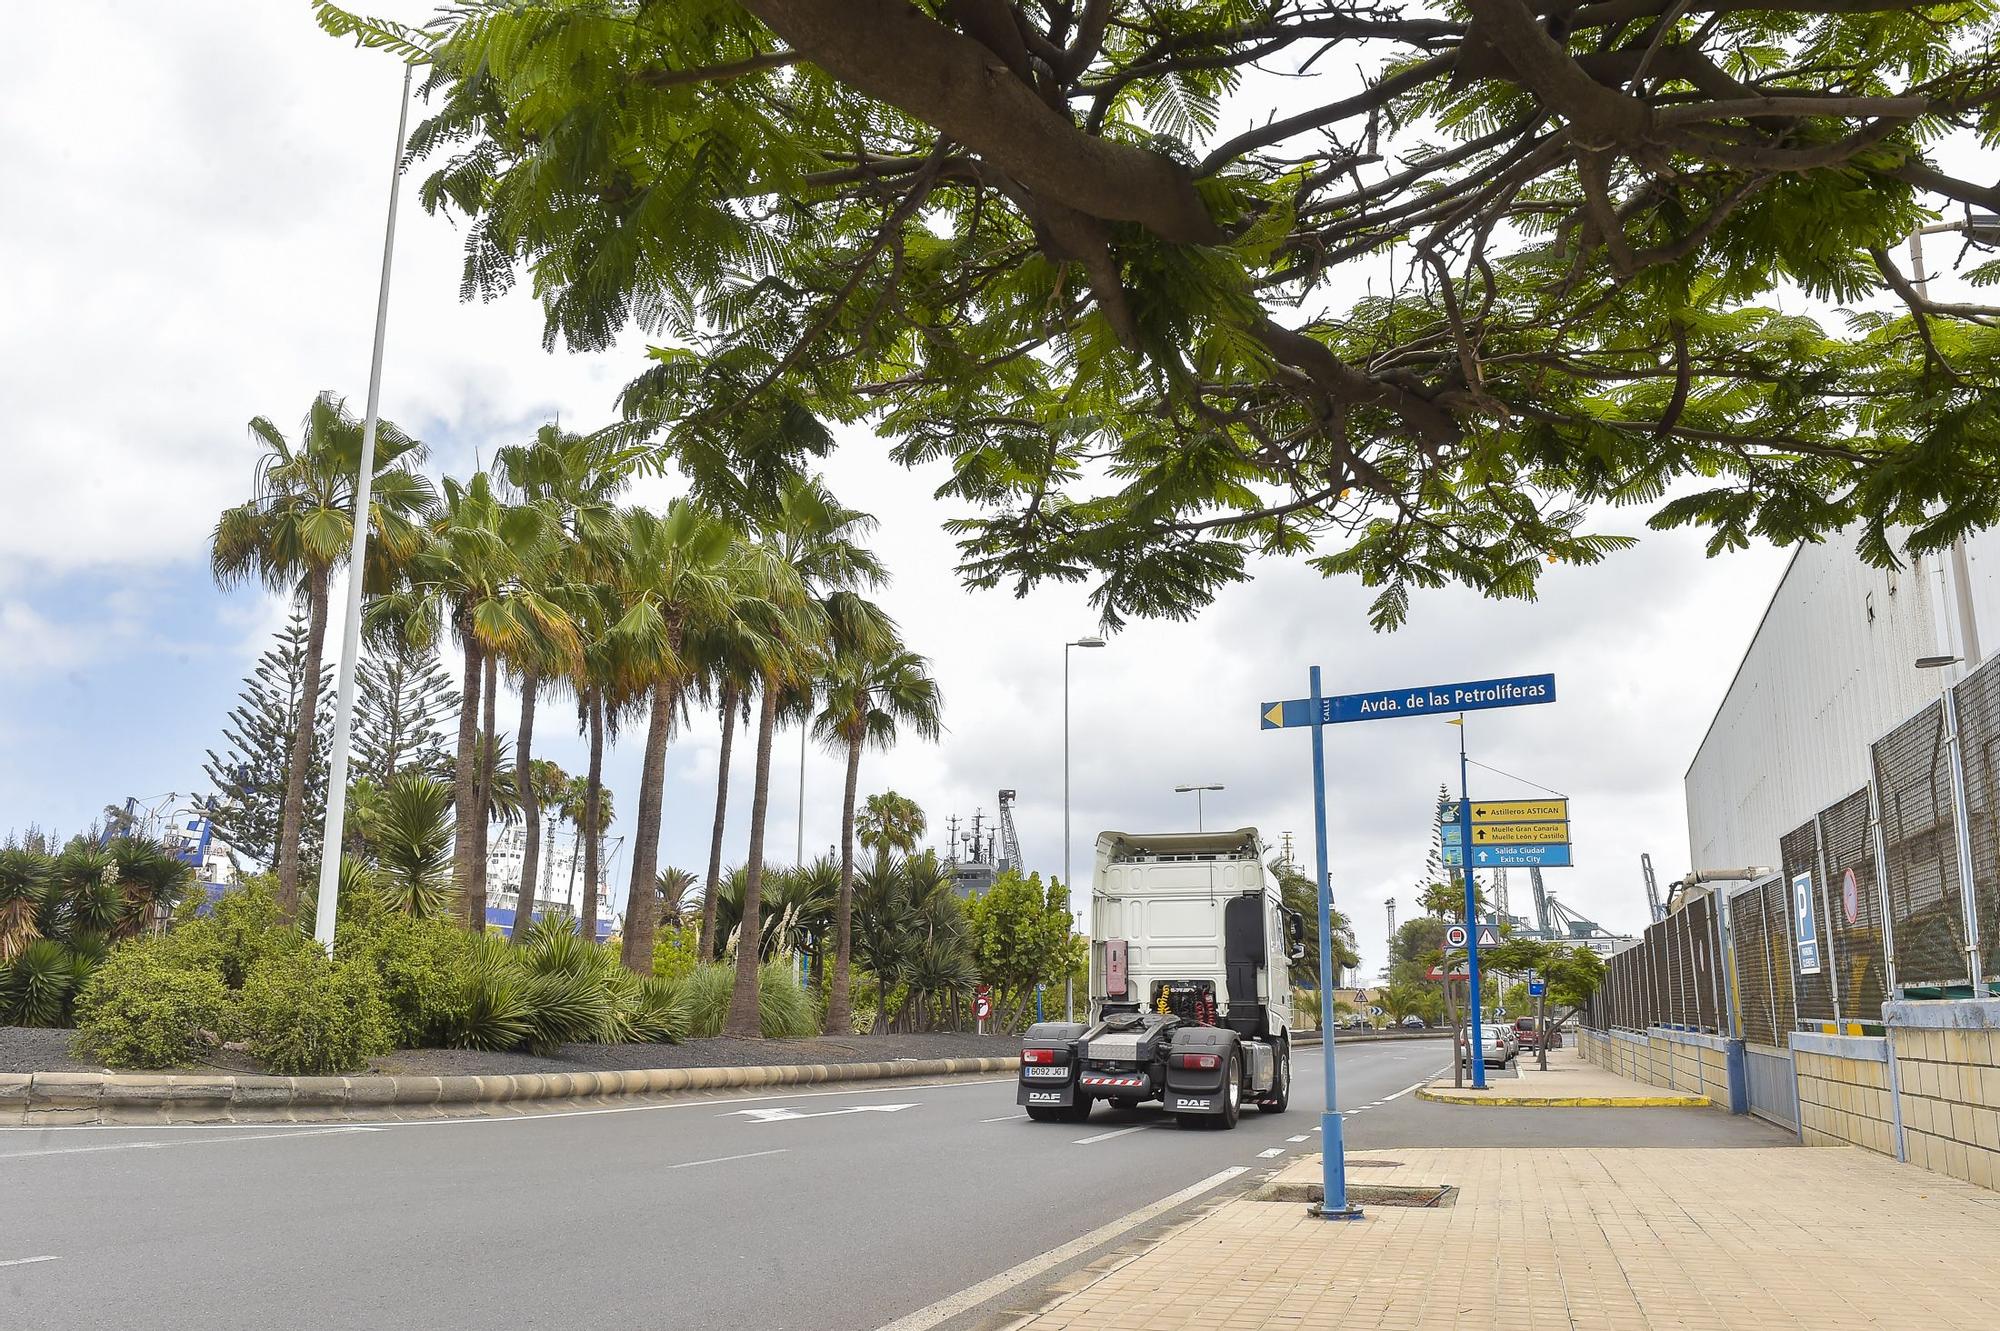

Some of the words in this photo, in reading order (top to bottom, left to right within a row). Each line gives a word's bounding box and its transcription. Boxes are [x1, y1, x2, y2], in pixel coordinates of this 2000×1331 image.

[1360, 696, 1401, 713] Avda.
[1406, 693, 1424, 709] de
[1429, 691, 1450, 706] las
[1455, 683, 1546, 704] Petrolíferas
[1491, 808, 1525, 816] Astilleros
[1527, 807, 1559, 815] ASTICAN
[1495, 847, 1518, 855] Salida
[1519, 846, 1545, 854] Ciudad
[1526, 855, 1541, 863] City
[1797, 884, 1808, 937] P
[1031, 1067, 1050, 1076] 6092
[1052, 1067, 1066, 1076] JGT
[1029, 1092, 1061, 1100] DAF
[1176, 1098, 1211, 1107] DAF
